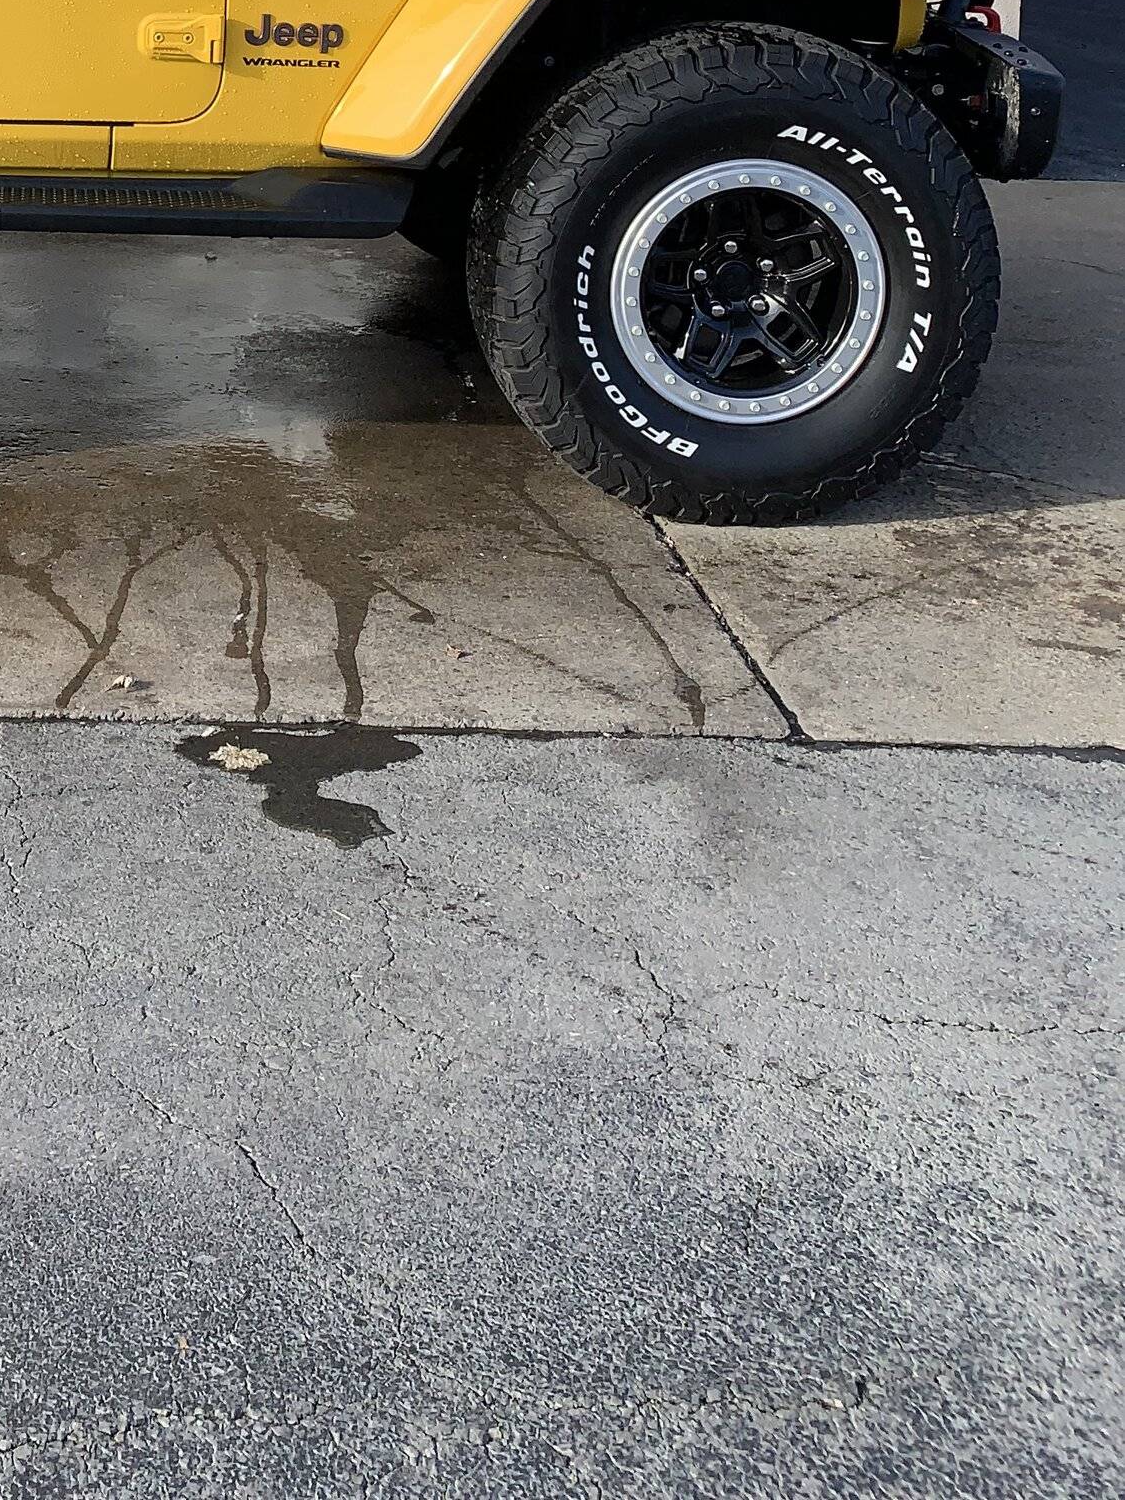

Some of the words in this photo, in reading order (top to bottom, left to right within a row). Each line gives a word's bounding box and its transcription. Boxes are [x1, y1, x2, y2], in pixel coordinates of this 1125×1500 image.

[242, 56, 340, 68] WRANGLER
[244, 13, 344, 54] Jeep
[776, 124, 932, 289] All-Terrain
[895, 311, 933, 373] T/A
[573, 243, 700, 459] BFGoodrich
